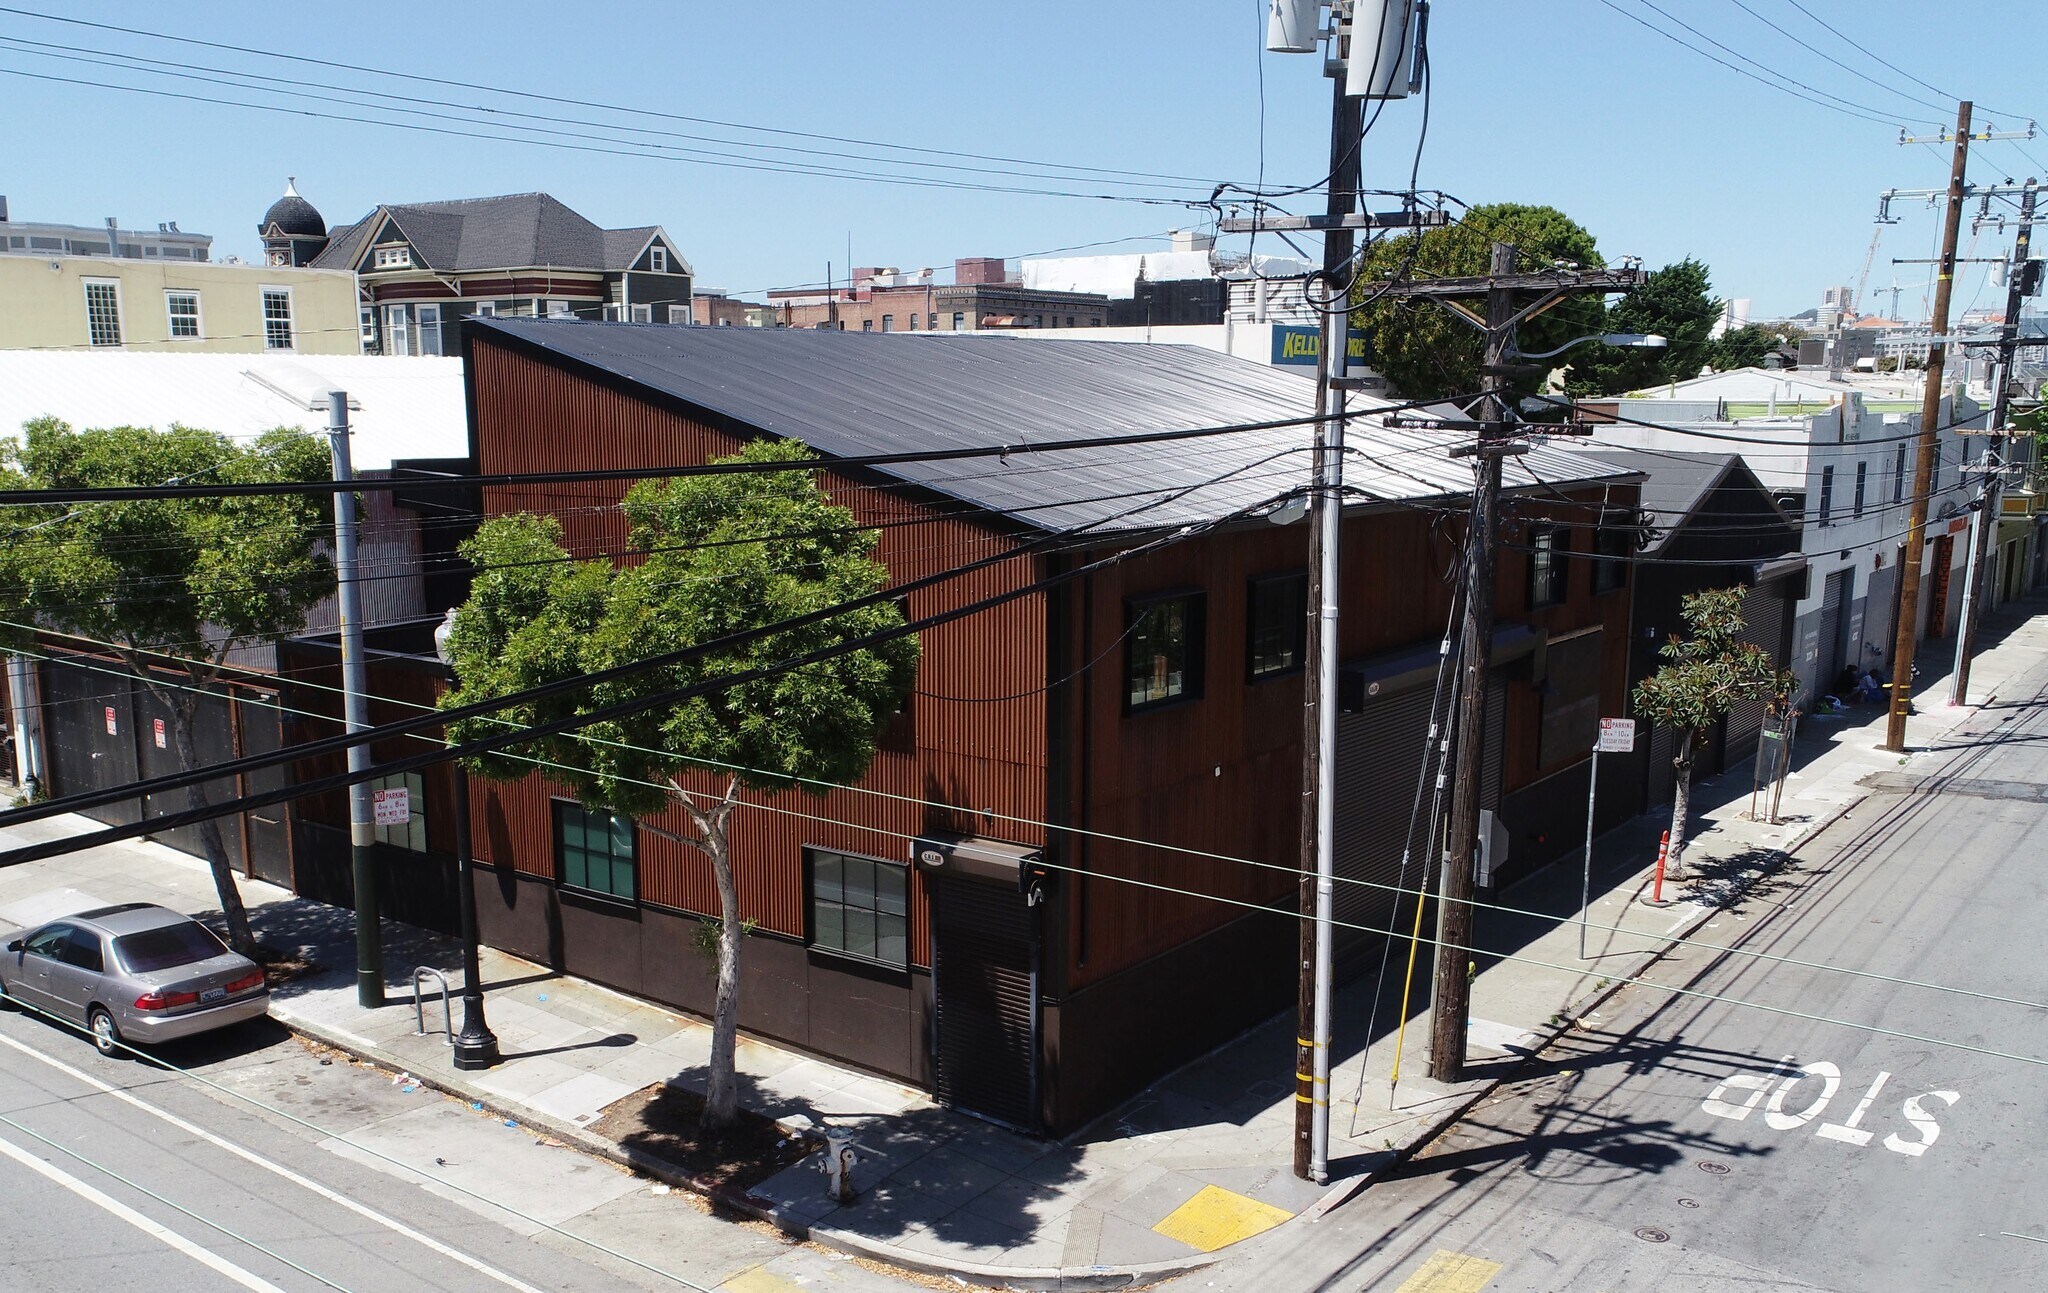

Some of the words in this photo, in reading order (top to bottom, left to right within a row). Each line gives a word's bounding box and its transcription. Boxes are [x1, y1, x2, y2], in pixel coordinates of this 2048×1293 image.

[1601, 719, 1611, 728] NO
[1612, 721, 1633, 729] PARKING
[374, 791, 384, 801] NO
[386, 791, 406, 799] PARKING
[1702, 1055, 1954, 1157] STOP
